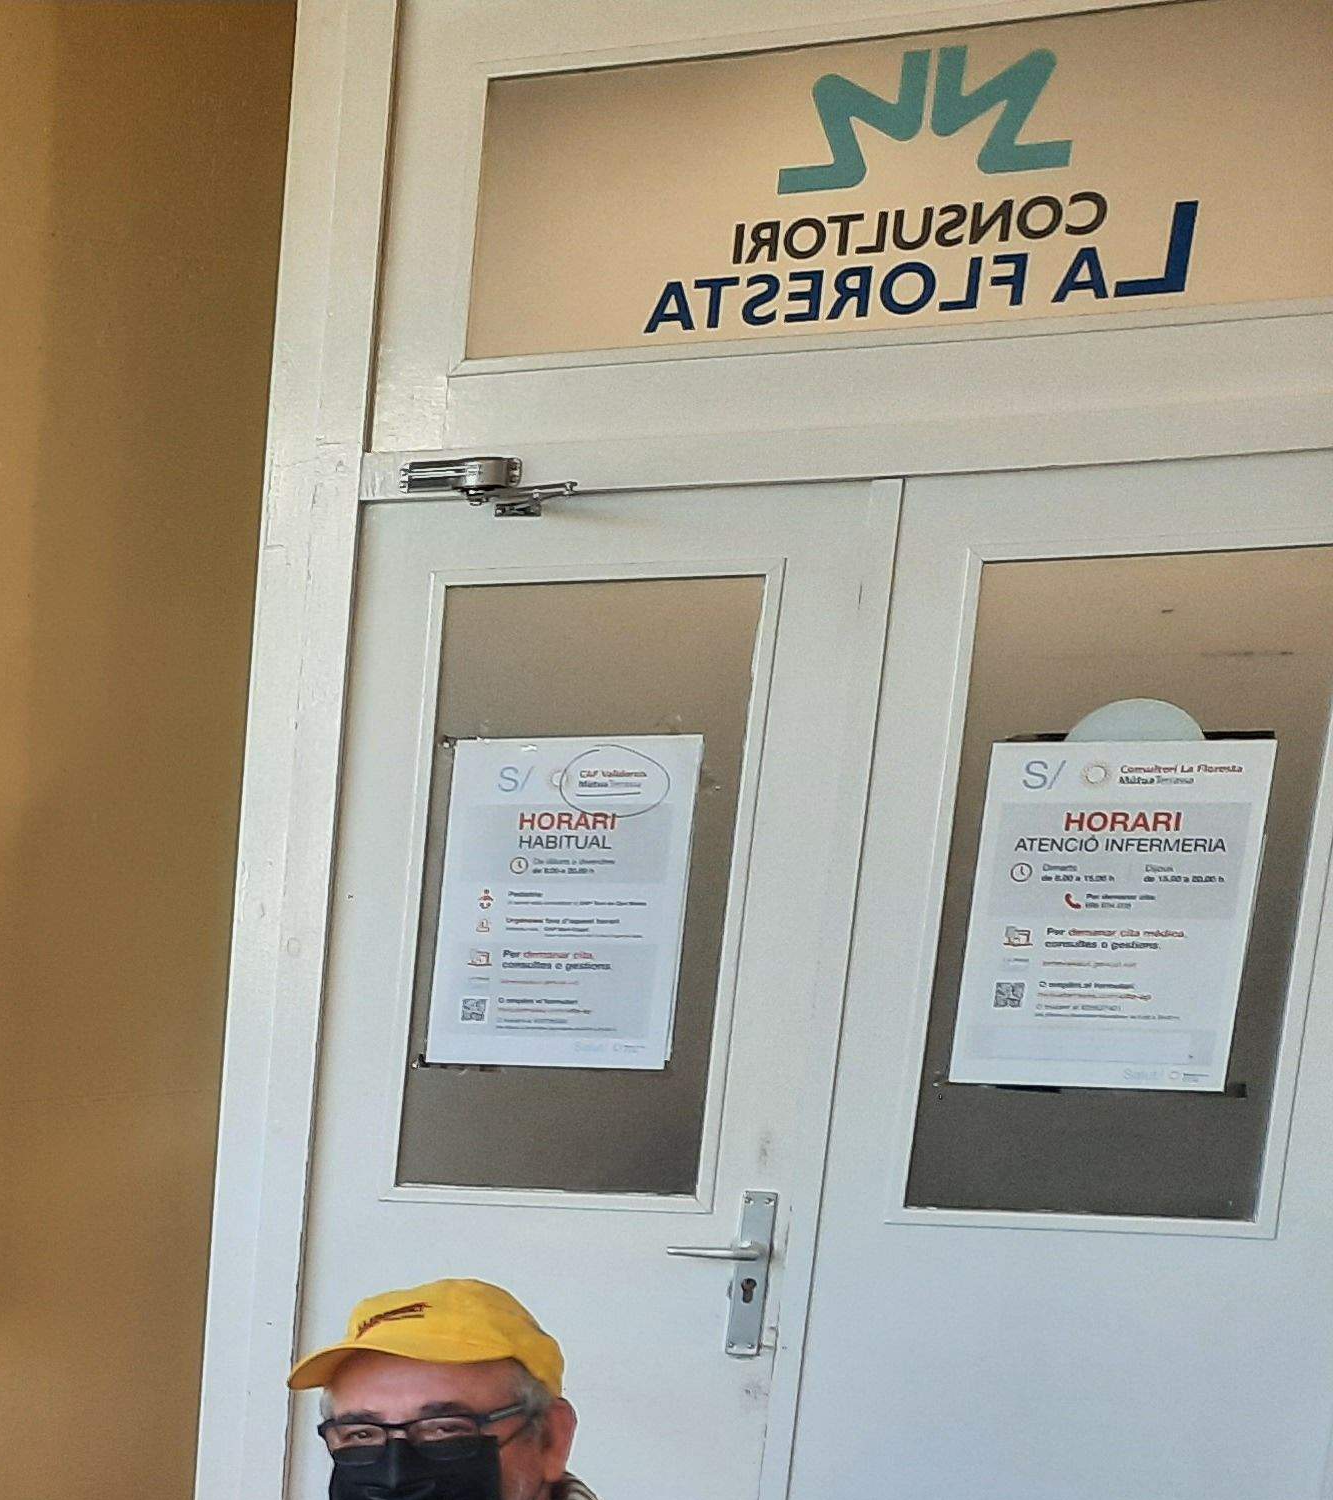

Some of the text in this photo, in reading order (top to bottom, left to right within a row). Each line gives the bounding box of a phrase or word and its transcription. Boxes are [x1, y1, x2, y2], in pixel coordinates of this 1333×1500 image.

[518, 812, 618, 831] HORARI
[1064, 812, 1182, 832] HORARI
[519, 835, 612, 850] HABITUAL
[1014, 835, 1226, 852] ATENCIÓ INFERMERIA
[1047, 927, 1065, 936] Per
